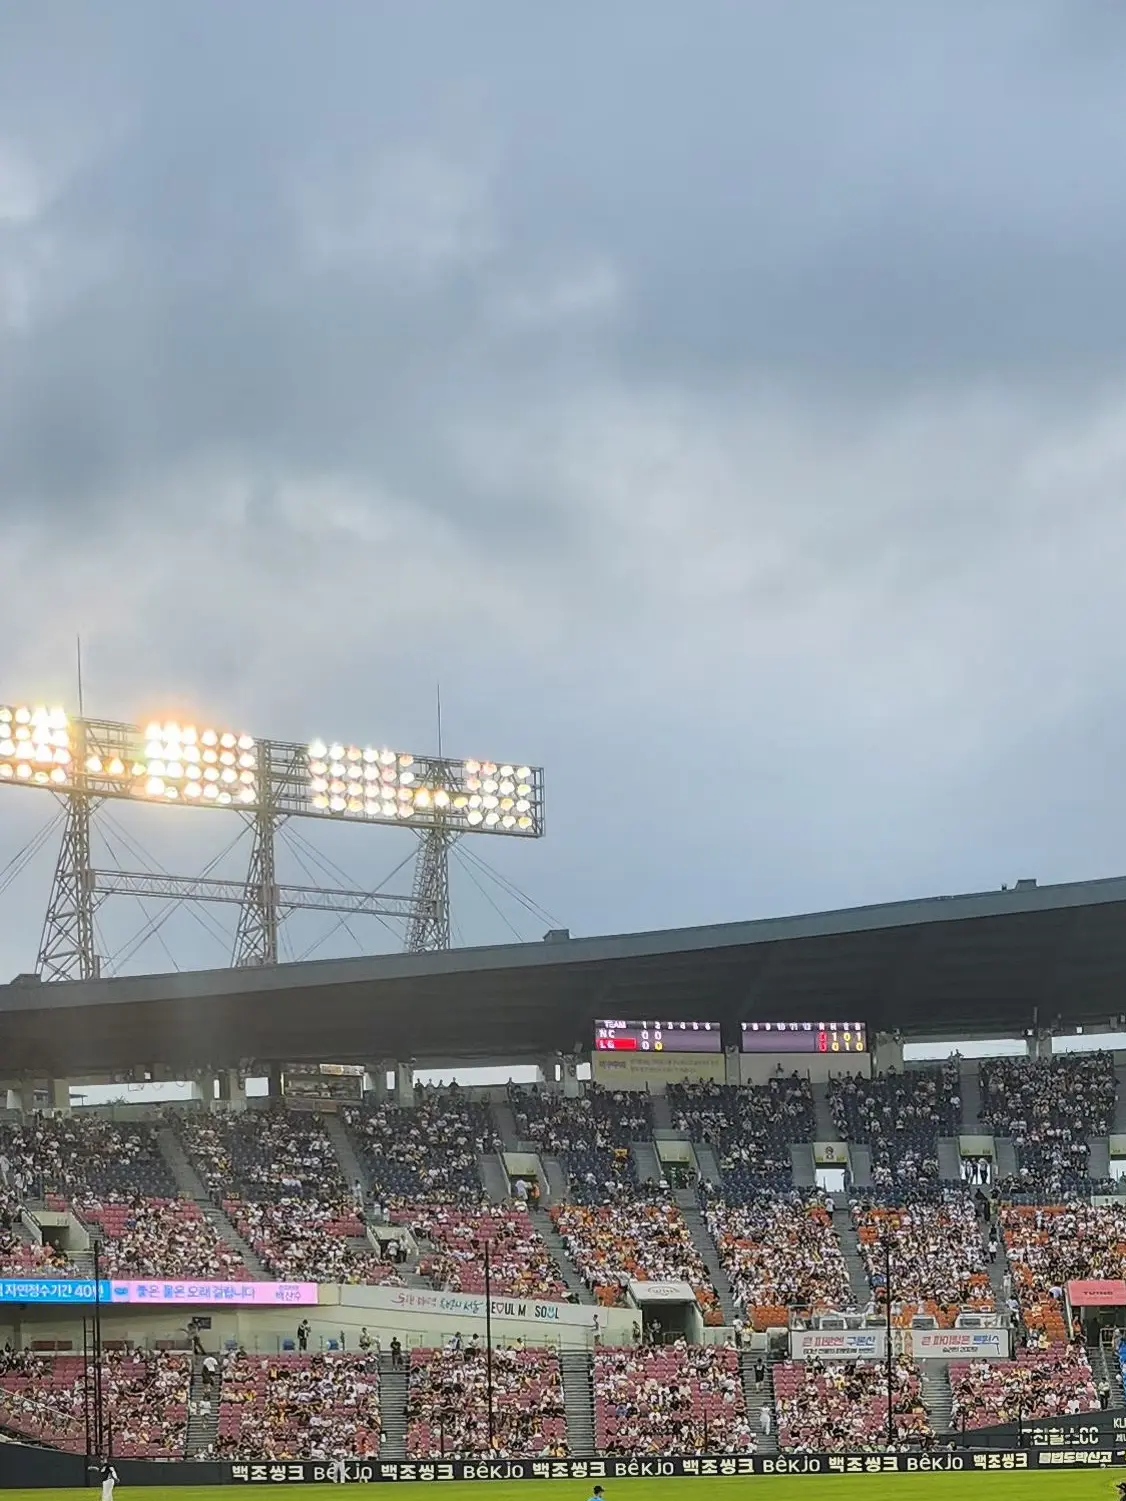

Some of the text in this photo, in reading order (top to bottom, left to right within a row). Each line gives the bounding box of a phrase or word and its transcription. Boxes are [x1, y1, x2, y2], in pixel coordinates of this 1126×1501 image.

[604, 1020, 626, 1029] TEAM
[777, 1022, 785, 1031] 10
[641, 1031, 649, 1040] 0
[655, 1031, 662, 1040] 0
[843, 1032, 851, 1041] 0
[642, 1041, 650, 1050] 0
[655, 1041, 663, 1051] 0
[831, 1042, 839, 1051] 0
[855, 1042, 863, 1051] 0
[5, 1283, 72, 1298] 자연정수기간
[535, 1305, 559, 1319] SOUL
[232, 1465, 304, 1482] 백조씽크
[381, 1464, 454, 1481] 백조씽크
[533, 1461, 606, 1478] 백조씽크
[683, 1458, 755, 1475] 백조씽크
[829, 1456, 898, 1472] 백조씽크
[973, 1453, 1028, 1470] 백조씽크
